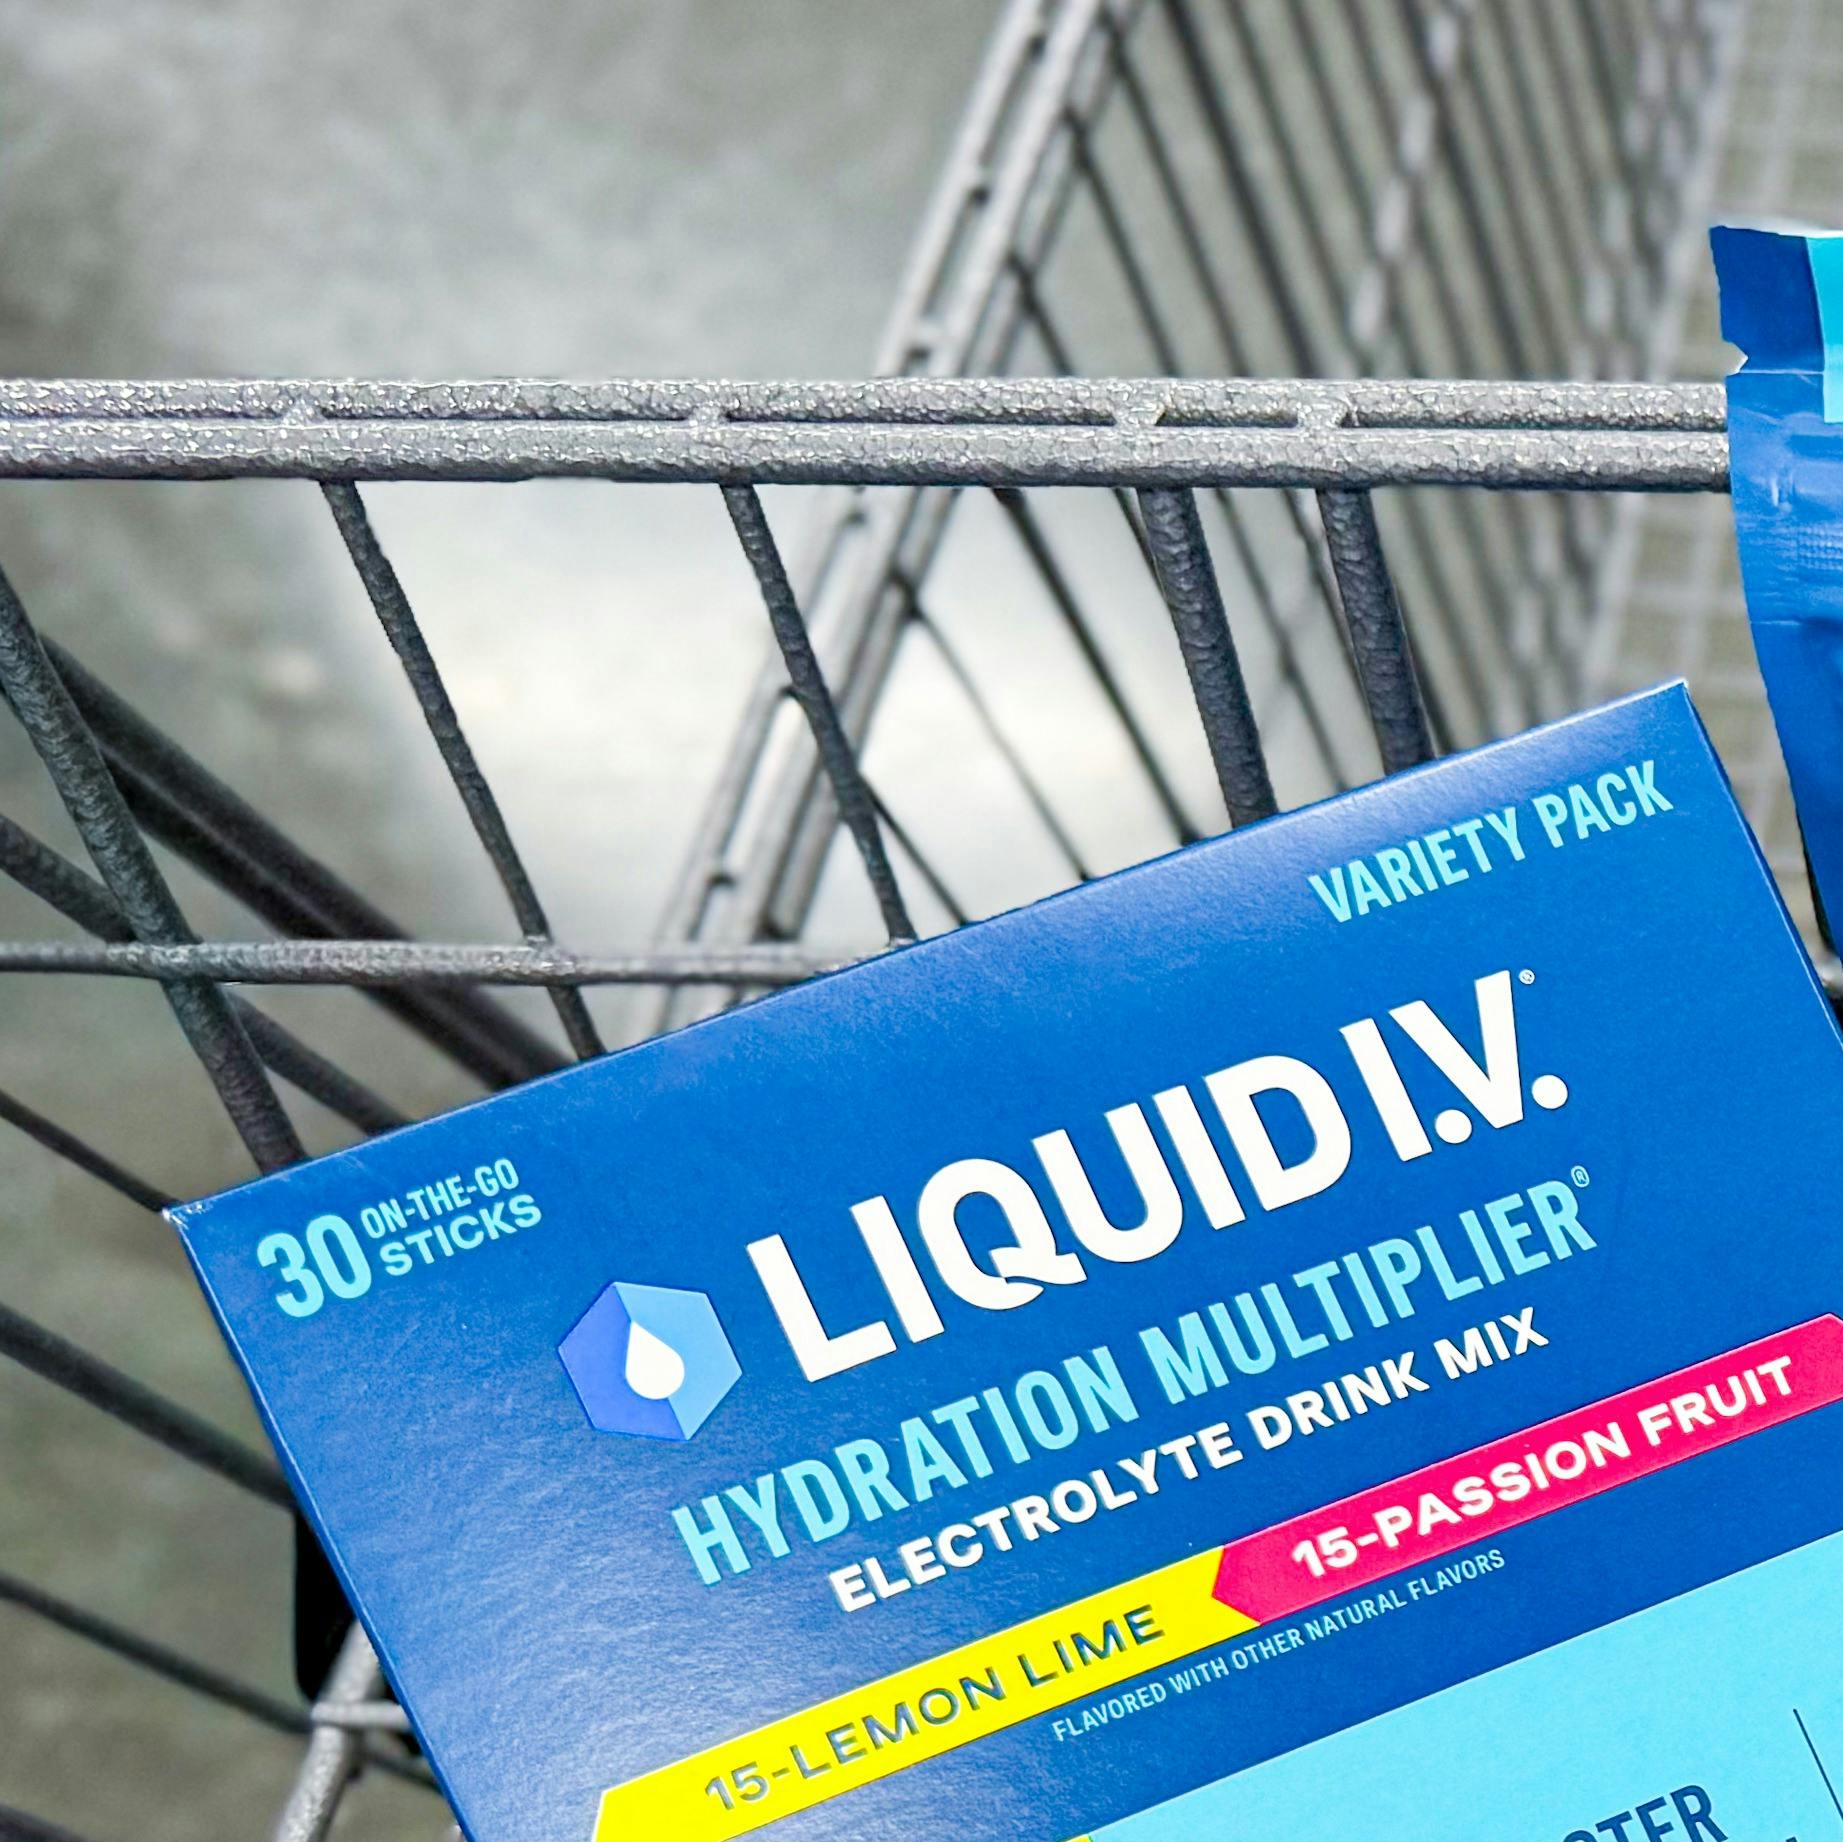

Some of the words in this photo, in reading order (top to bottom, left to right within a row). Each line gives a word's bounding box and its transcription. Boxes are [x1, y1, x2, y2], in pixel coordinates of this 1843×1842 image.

[1308, 806, 1527, 923] VARIETY
[1533, 760, 1673, 849] PACK
[256, 1213, 372, 1318] 30
[361, 1158, 520, 1240] ON-THE-GO
[380, 1193, 543, 1277] STICKS
[747, 1054, 1352, 1382] LIQUID
[1340, 970, 1569, 1162] I.V.
[670, 1346, 1141, 1586] HYDRATION
[1143, 1179, 1598, 1405] MULTIPLIER
[828, 1421, 1245, 1613] ELECTROLYTE
[1246, 1352, 1429, 1450] DRINK
[1436, 1306, 1550, 1381] MIX
[1291, 1421, 1631, 1577] 15-PASSION
[1636, 1355, 1795, 1447] FRUIT
[704, 1668, 1006, 1812] 15-LEMON
[1016, 1603, 1166, 1688] LIME
[1051, 1682, 1168, 1742] FLAVORED
[1167, 1657, 1229, 1693] WITH
[1231, 1627, 1305, 1671] OTHER
[1304, 1588, 1408, 1641] NATURAL
[1407, 1548, 1507, 1600] FLAVORS
